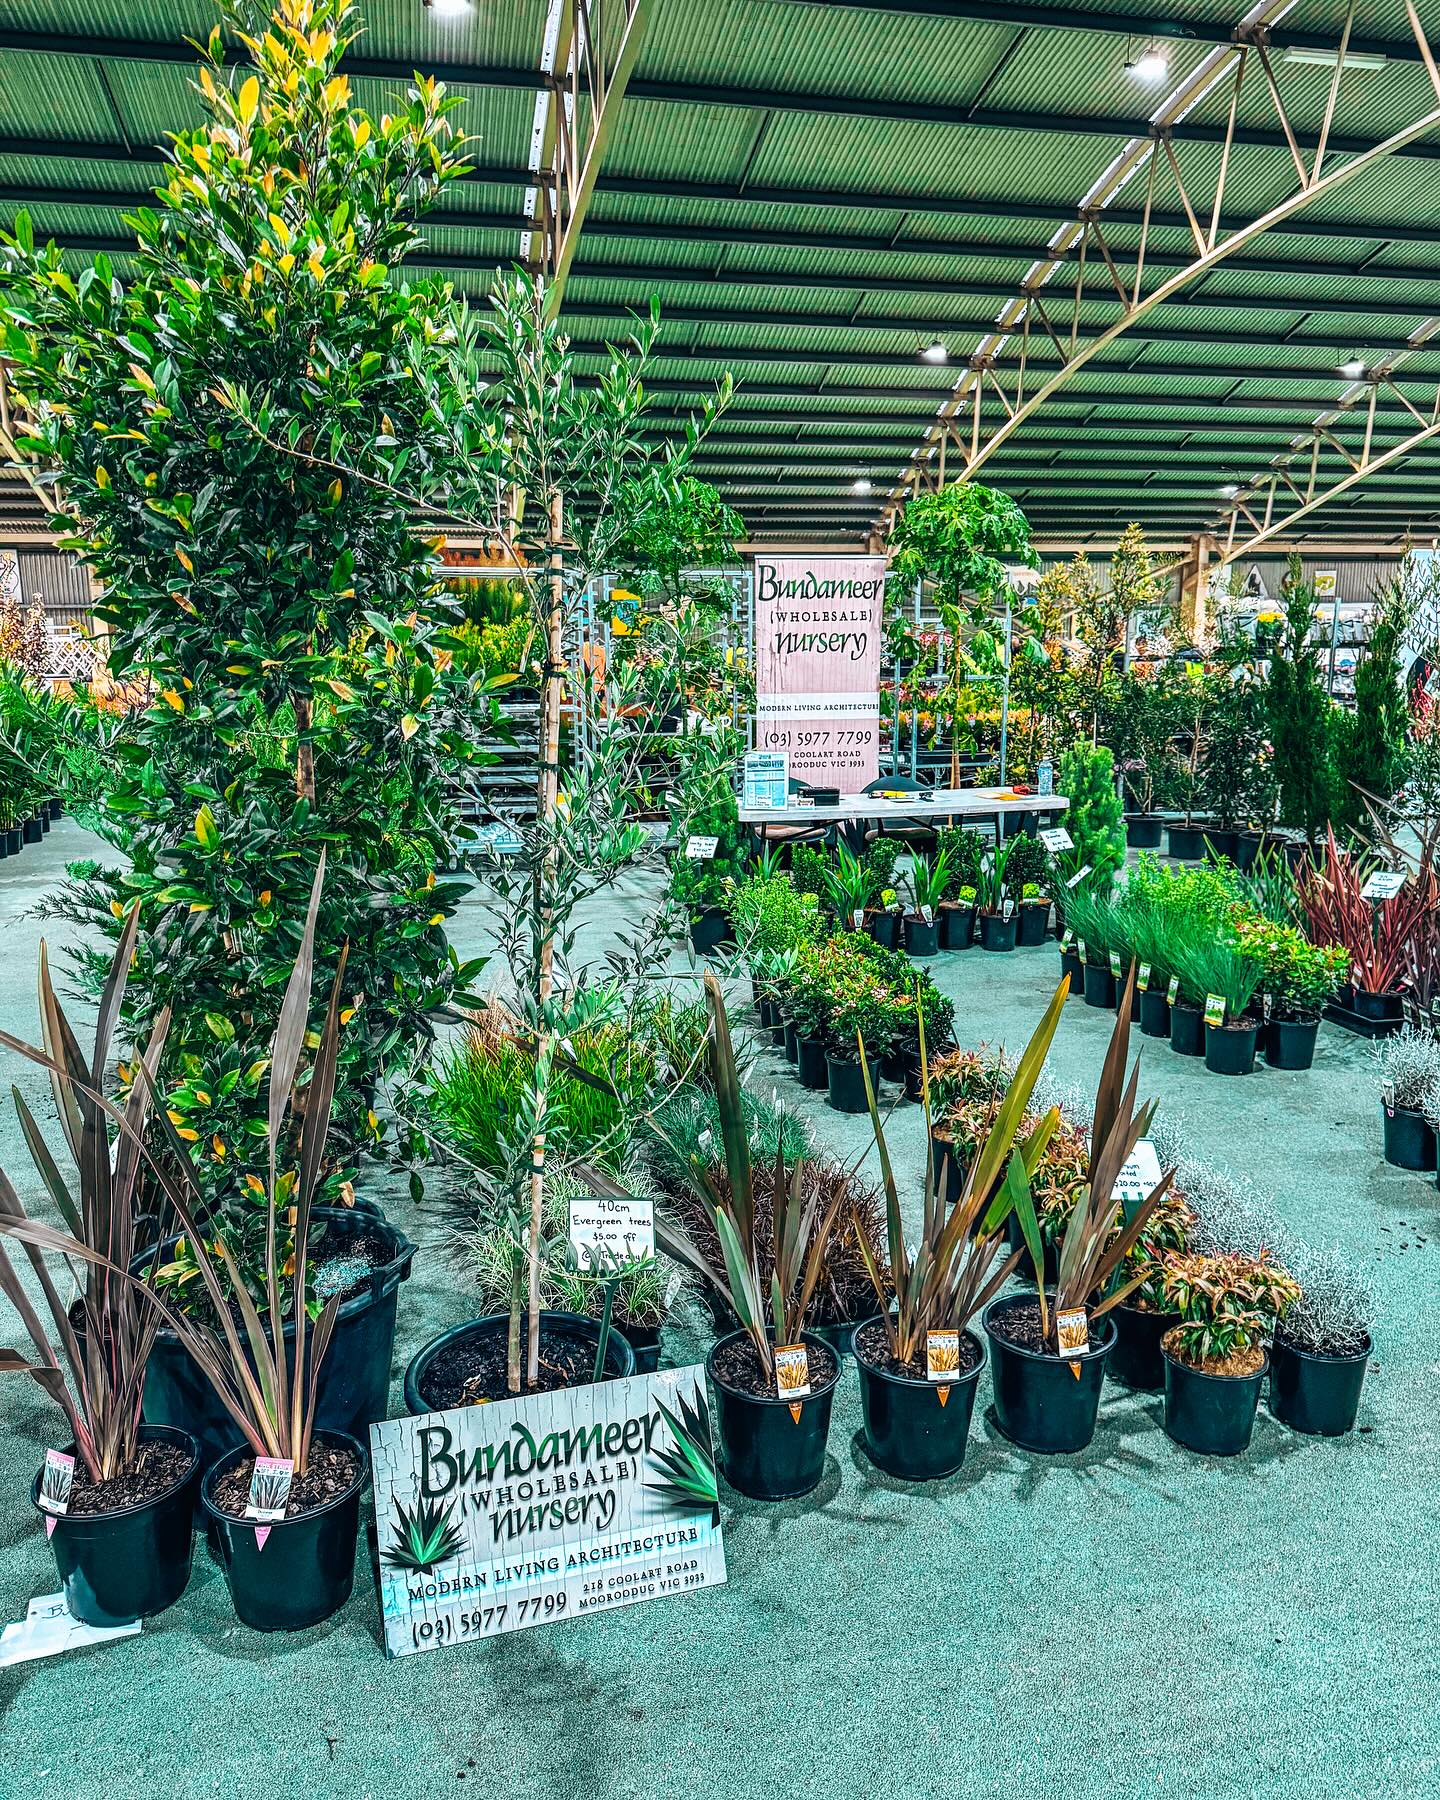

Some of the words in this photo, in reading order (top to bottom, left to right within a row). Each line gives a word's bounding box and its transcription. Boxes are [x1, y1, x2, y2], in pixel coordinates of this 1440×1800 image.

[758, 565, 882, 601] Bundameer
[770, 609, 873, 624] (WHOLESALE)
[775, 632, 867, 660] nursery
[765, 731, 791, 747] (03)
[797, 732, 830, 746] 5977
[837, 731, 872, 745] 7799
[572, 1215, 622, 1229] Evergreen
[629, 1217, 652, 1227] trees
[598, 1200, 630, 1212] 40cm
[593, 1232, 618, 1242] $5.00
[623, 1232, 637, 1242] off
[416, 1410, 661, 1498] Bundameer
[462, 1456, 638, 1517] (WHOLESALE)
[489, 1489, 616, 1543] nursery
[408, 1572, 488, 1601] MODERN
[495, 1557, 560, 1583] LIVING
[566, 1527, 698, 1567] ARCHITECTURE
[583, 1579, 604, 1593] 218
[608, 1567, 662, 1587] COOLART
[667, 1559, 699, 1574] ROAD
[578, 1583, 656, 1608] MOOROODUC
[660, 1577, 681, 1590] VIC
[684, 1572, 706, 1585] 3933
[412, 1614, 452, 1648] (03)
[460, 1604, 509, 1635] 5977
[517, 1591, 568, 1624] 7799
